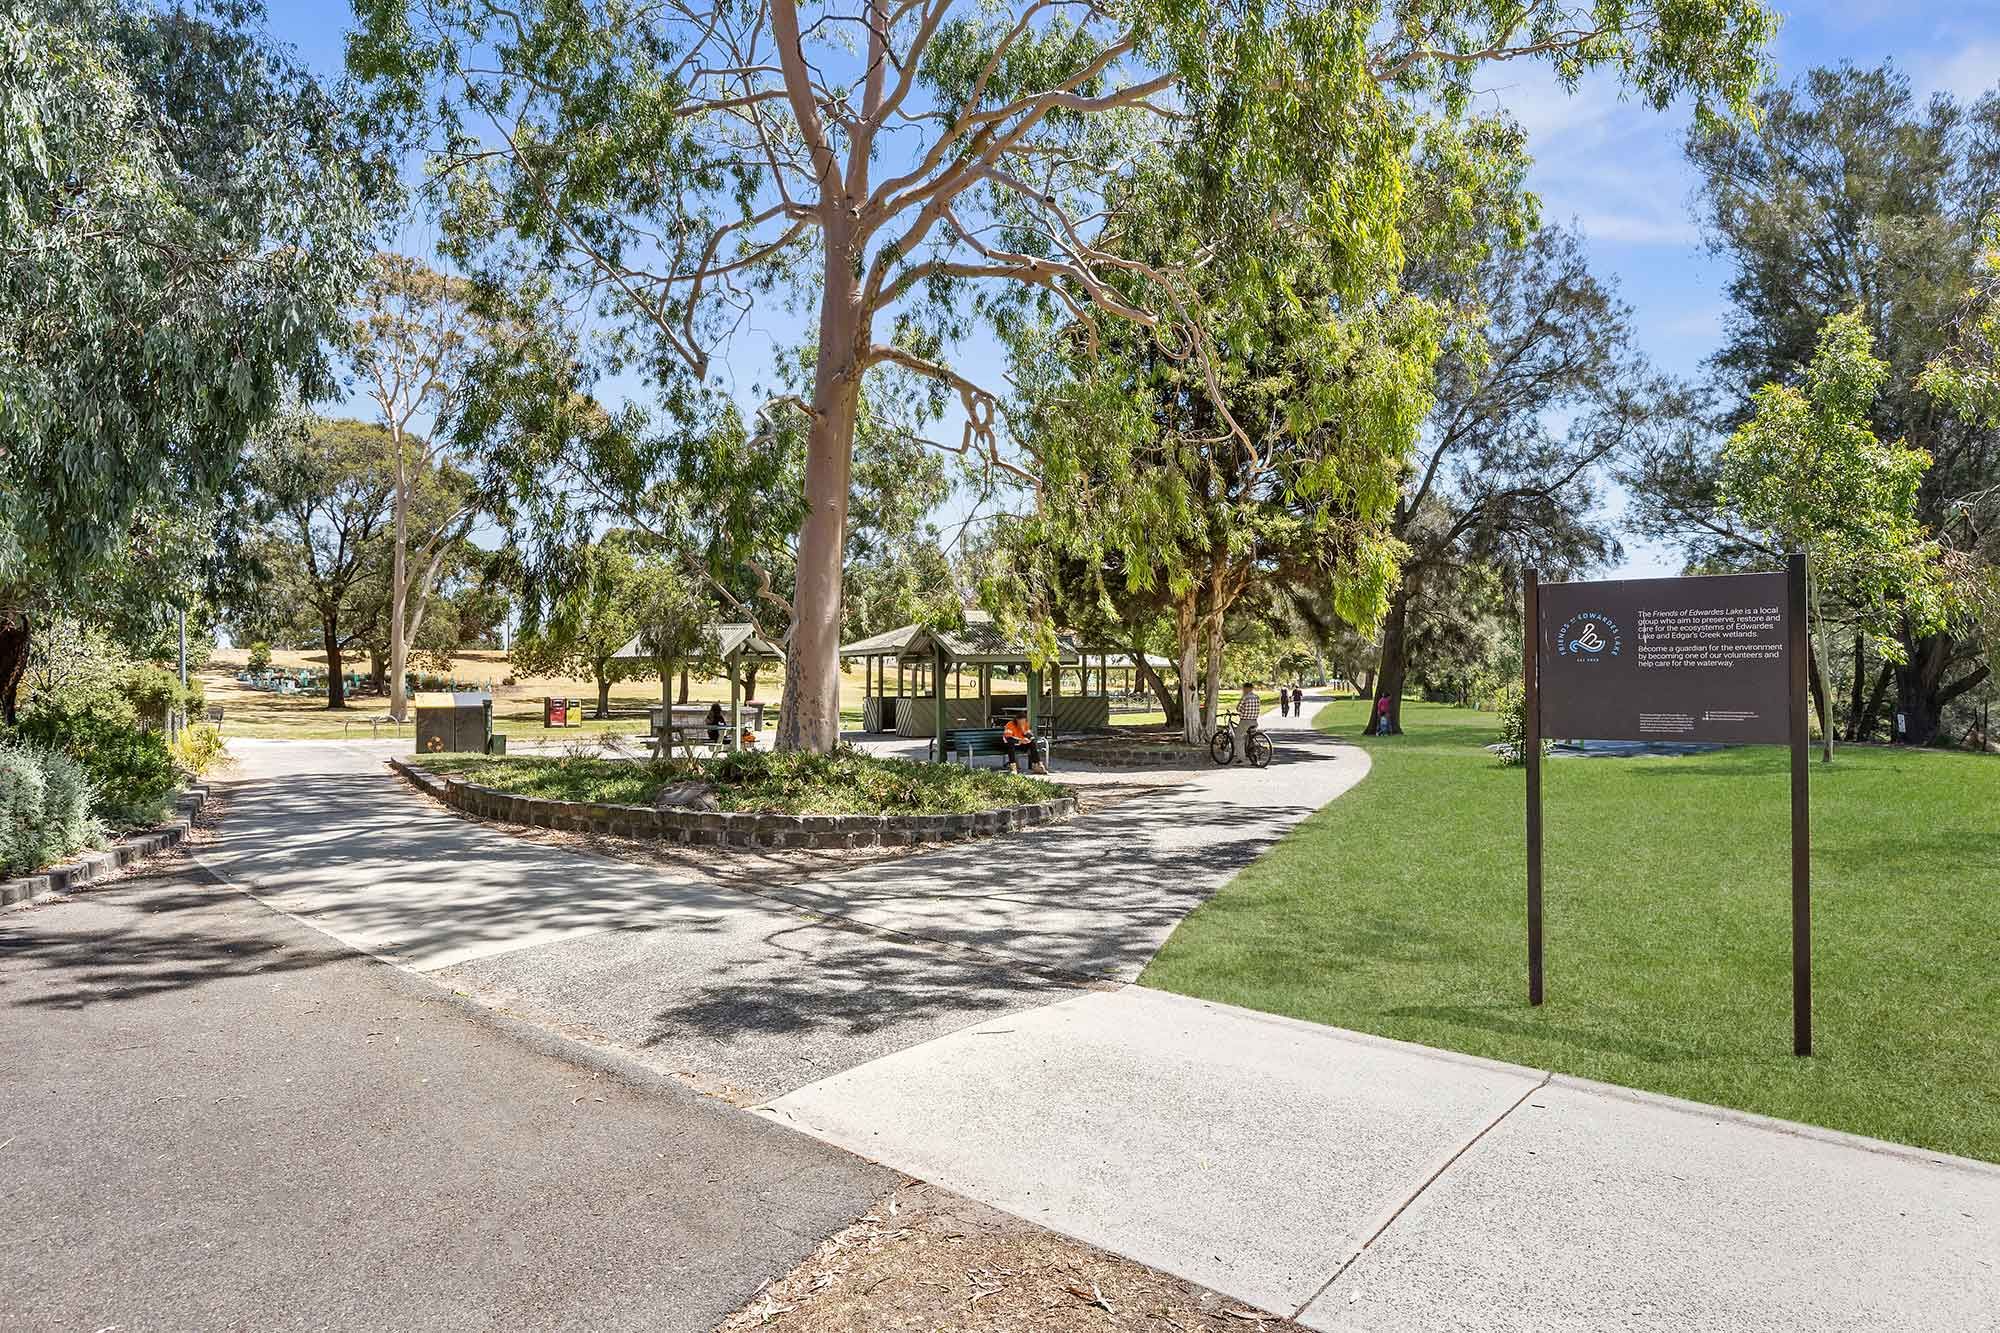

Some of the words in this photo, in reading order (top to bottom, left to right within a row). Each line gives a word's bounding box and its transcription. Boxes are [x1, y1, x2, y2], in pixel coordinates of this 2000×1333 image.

[1760, 606, 1779, 614] local
[1766, 614, 1780, 622] and
[1680, 624, 1724, 632] ecosystems
[1577, 612, 1619, 634] EDWARDES
[1610, 635, 1621, 656] LAKE
[1675, 644, 1708, 654] guardian
[1648, 652, 1684, 660] becoming
[1764, 650, 1780, 658] and
[1696, 660, 1734, 668] waterway.
